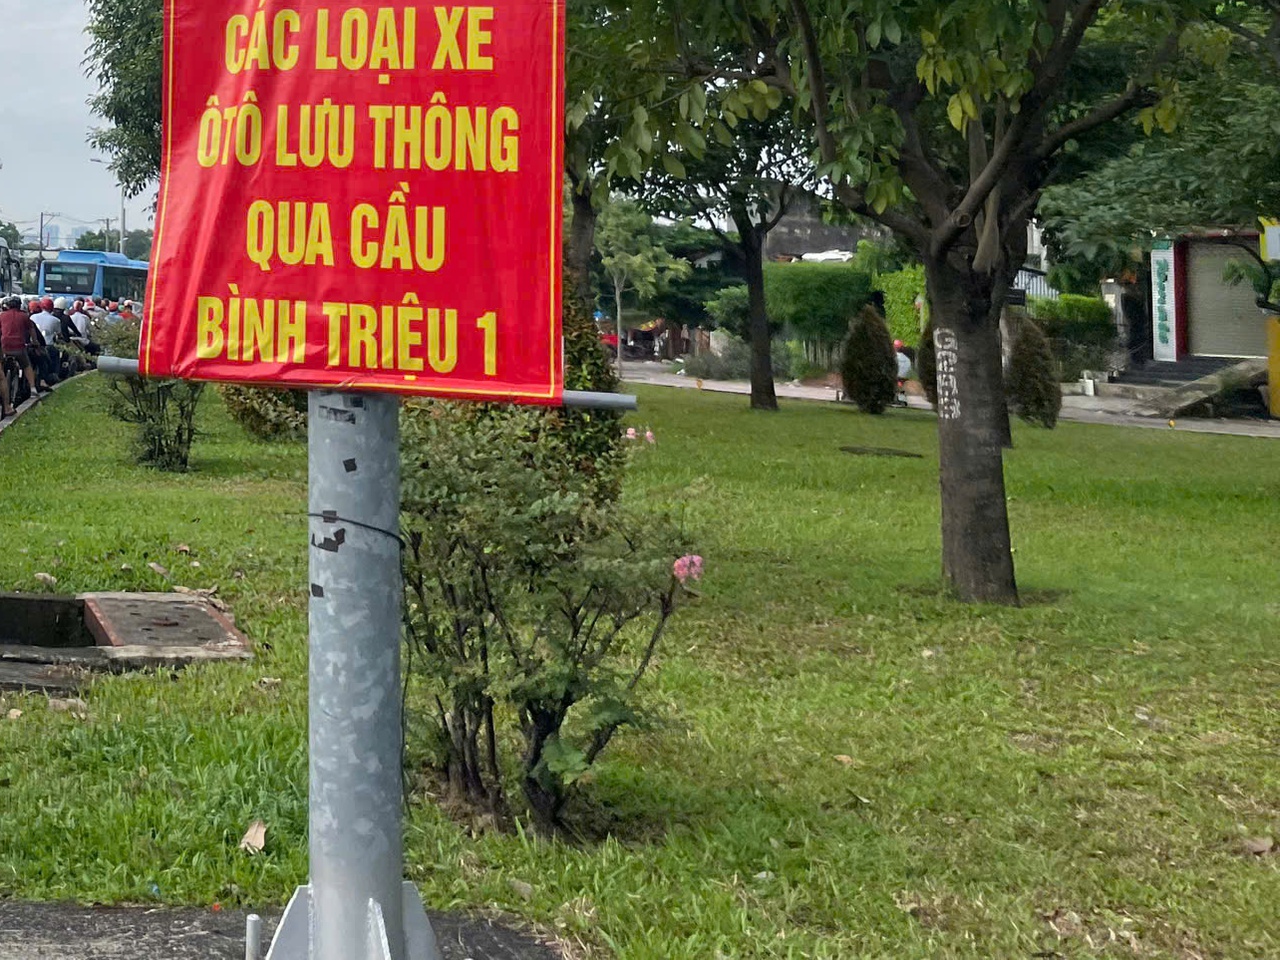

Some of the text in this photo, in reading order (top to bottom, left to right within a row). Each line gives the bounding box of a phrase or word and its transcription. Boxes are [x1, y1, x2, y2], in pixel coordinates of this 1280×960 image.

[315, 6, 416, 85] LOẠI
[433, 5, 495, 71] XE
[196, 91, 520, 173] ÔTÔ LƯU THÔNG
[246, 181, 446, 273] QUA CẦU
[195, 283, 498, 382] BÌNH TRIỆU 1
